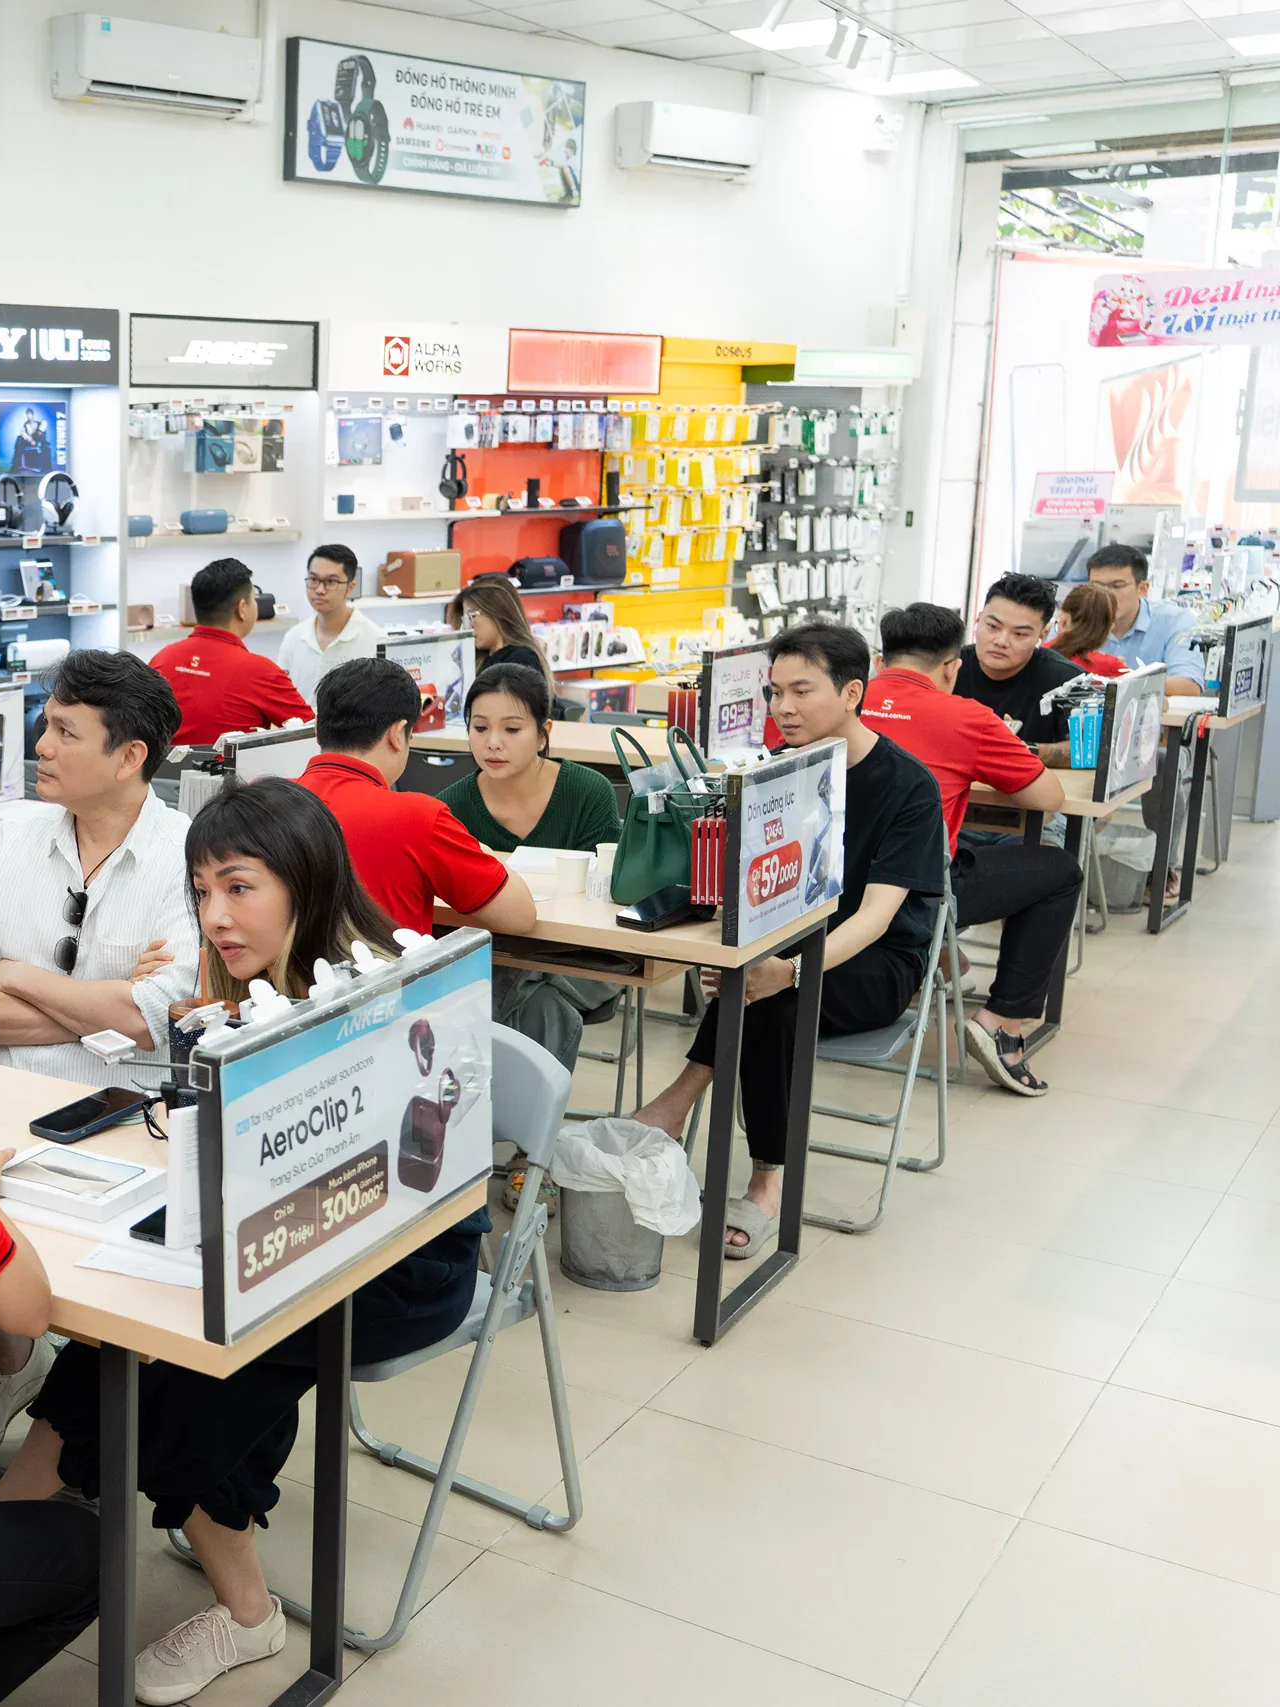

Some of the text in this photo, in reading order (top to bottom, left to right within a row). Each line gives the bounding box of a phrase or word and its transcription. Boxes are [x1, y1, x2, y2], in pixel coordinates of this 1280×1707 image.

[395, 66, 517, 100] ĐỒNG HỒ THÔNG MINH
[410, 91, 501, 119] ĐỒNG HỒ TRẺ EM
[395, 137, 431, 148] SAMSUNG
[416, 123, 443, 133] HUAWEI
[447, 126, 477, 137] GARMIN
[1163, 279, 1245, 307] Deal
[38, 327, 84, 361] ULT
[172, 340, 286, 365] BOSE
[413, 343, 460, 358] ALPHA
[413, 359, 462, 374] WORKS
[560, 339, 611, 386] JBL
[747, 790, 795, 822] Dán cường lực
[765, 822, 783, 841] ZAGG
[336, 999, 397, 1041] ANKER
[249, 1055, 375, 1127] Tai nghe dạng kẹp Anker soundcore
[260, 1085, 364, 1166] AeroClip 2
[269, 1131, 360, 1189] Trang Sức Của Thanh Âm
[328, 1156, 378, 1190] Mua kèm iPhone
[273, 1205, 285, 1222] Chỉ
[285, 1202, 296, 1217] từ
[243, 1222, 315, 1278] 3.59 Triệu
